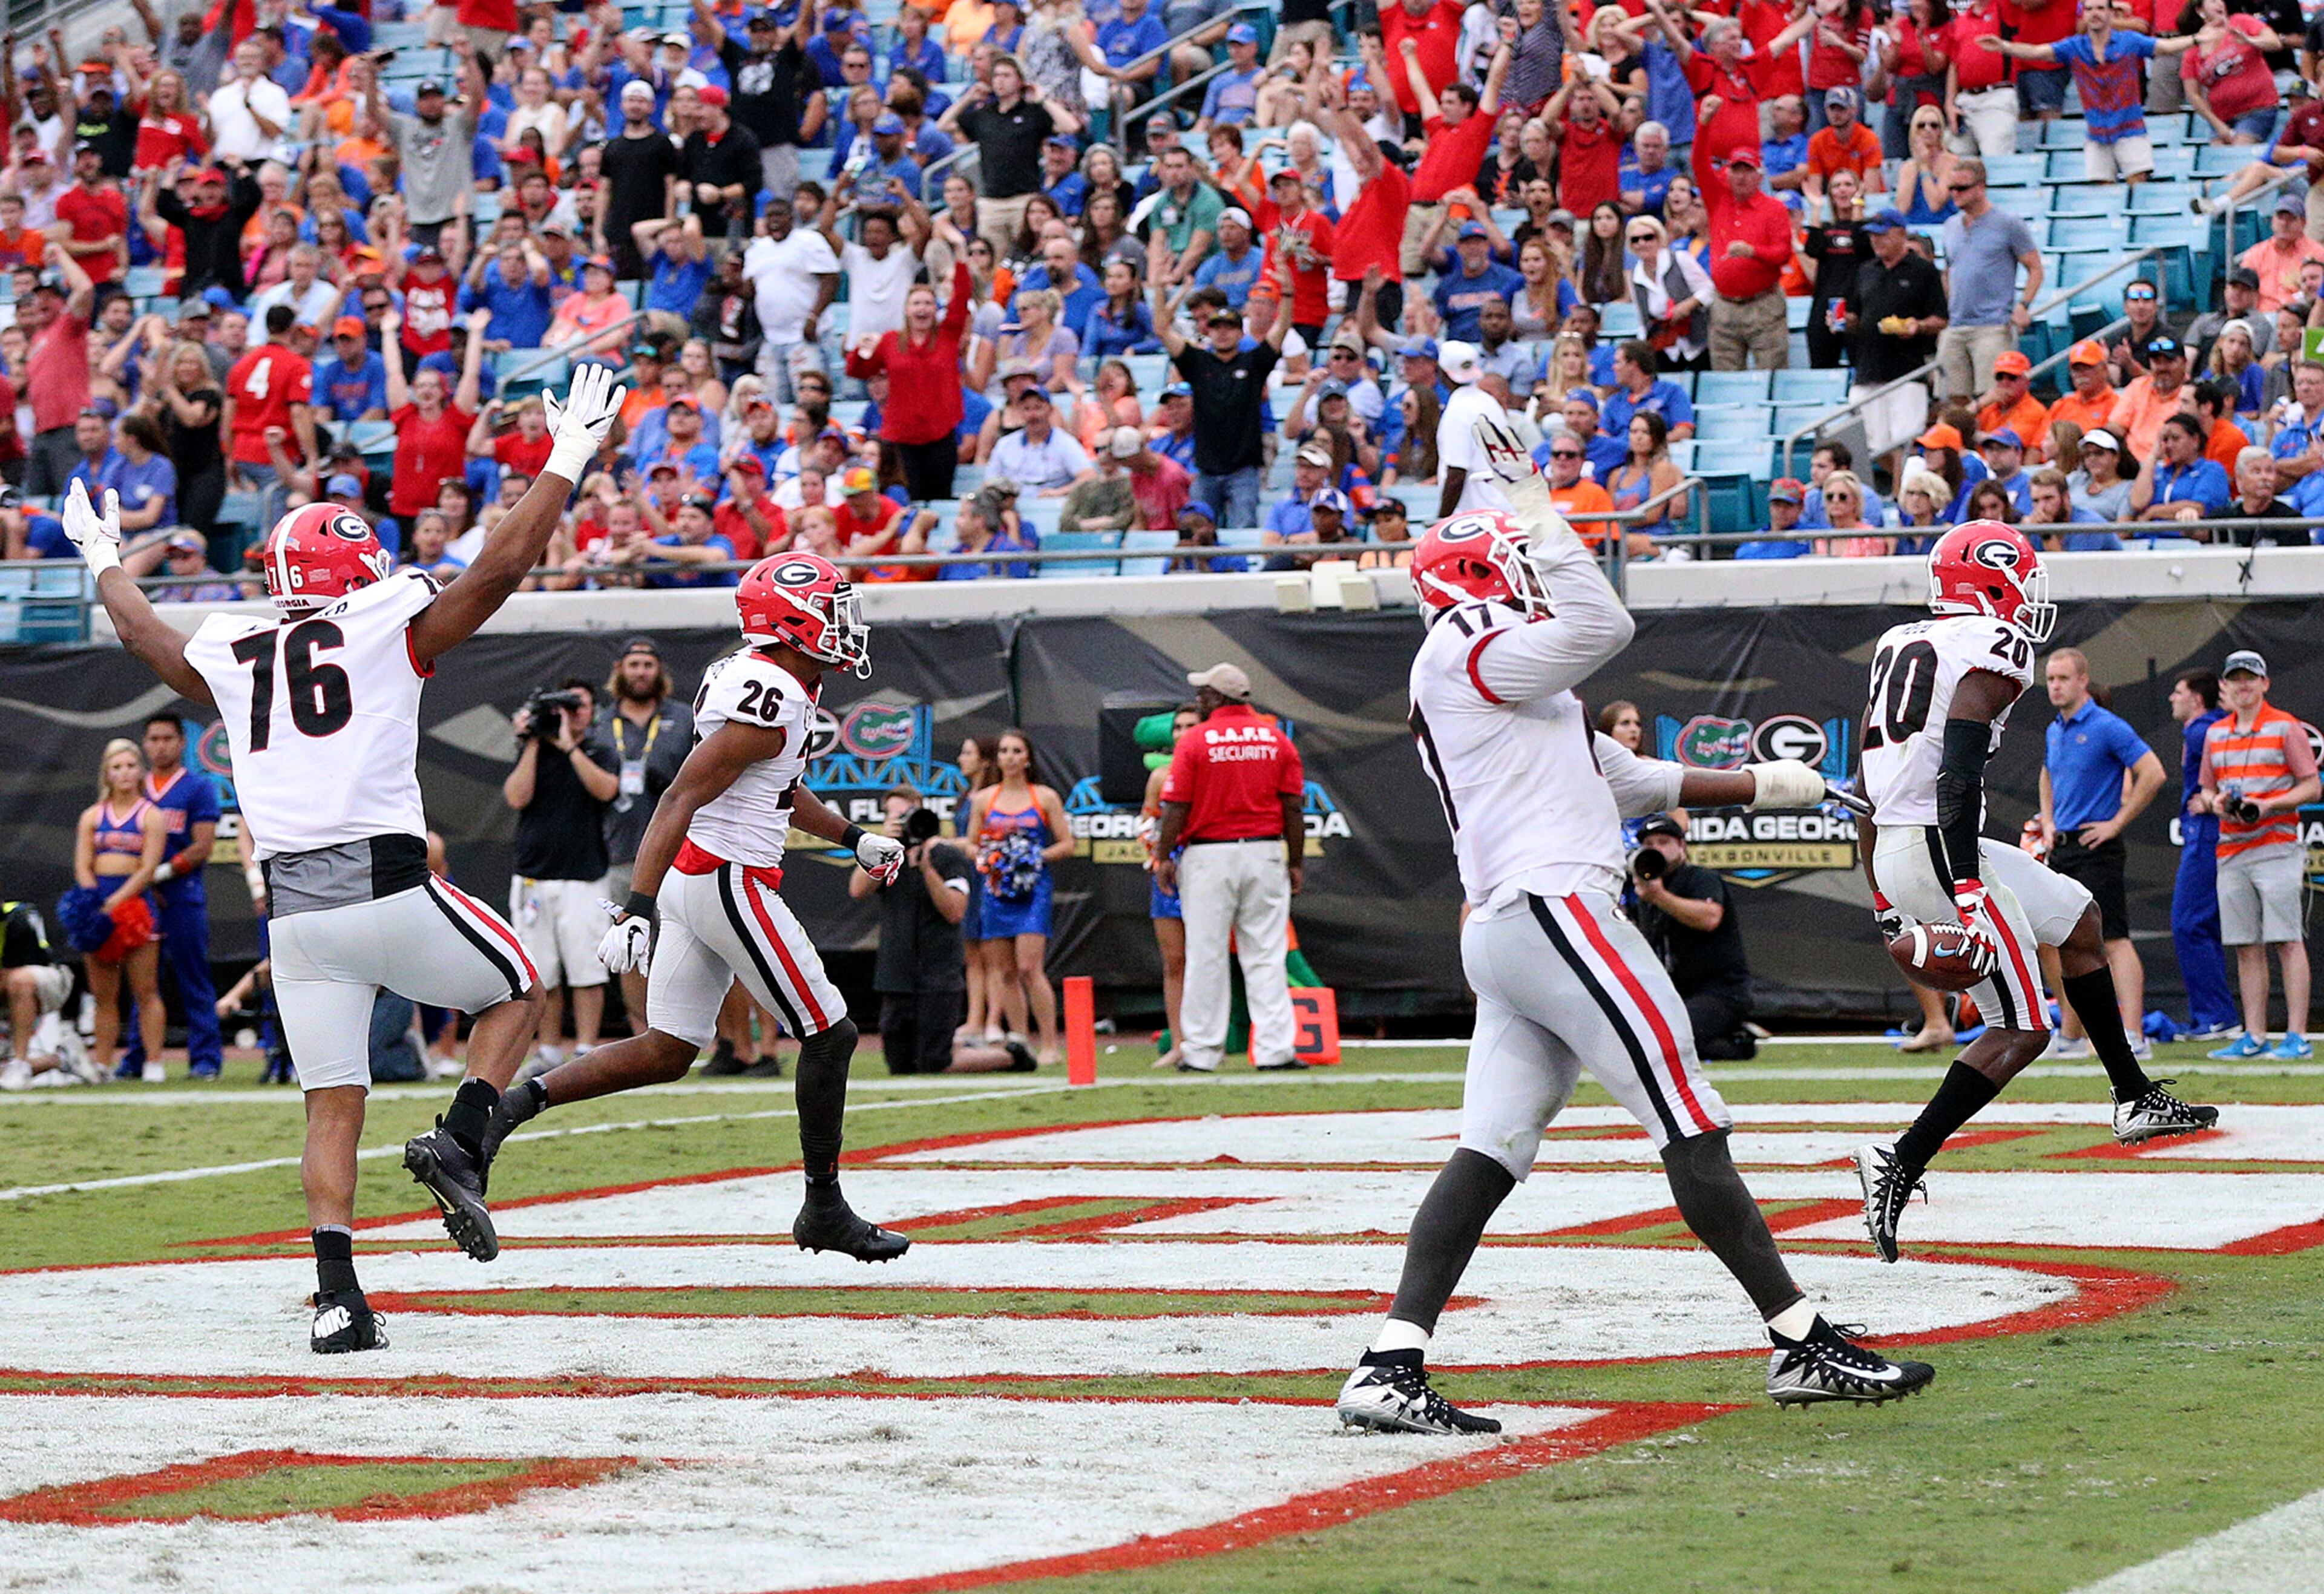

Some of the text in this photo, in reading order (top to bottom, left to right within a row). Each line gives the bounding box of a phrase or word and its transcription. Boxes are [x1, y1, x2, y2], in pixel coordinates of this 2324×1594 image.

[245, 356, 272, 399] 4
[772, 562, 820, 588] G
[1448, 605, 1494, 638] 17
[1989, 627, 2029, 669] 20
[231, 618, 353, 754] 76
[737, 680, 784, 722] 26
[1862, 640, 1938, 751] 20
[1208, 745, 1279, 764] SECURITY
[1686, 847, 1833, 862] CKSONVILLE
[313, 1305, 352, 1339] NIKE
